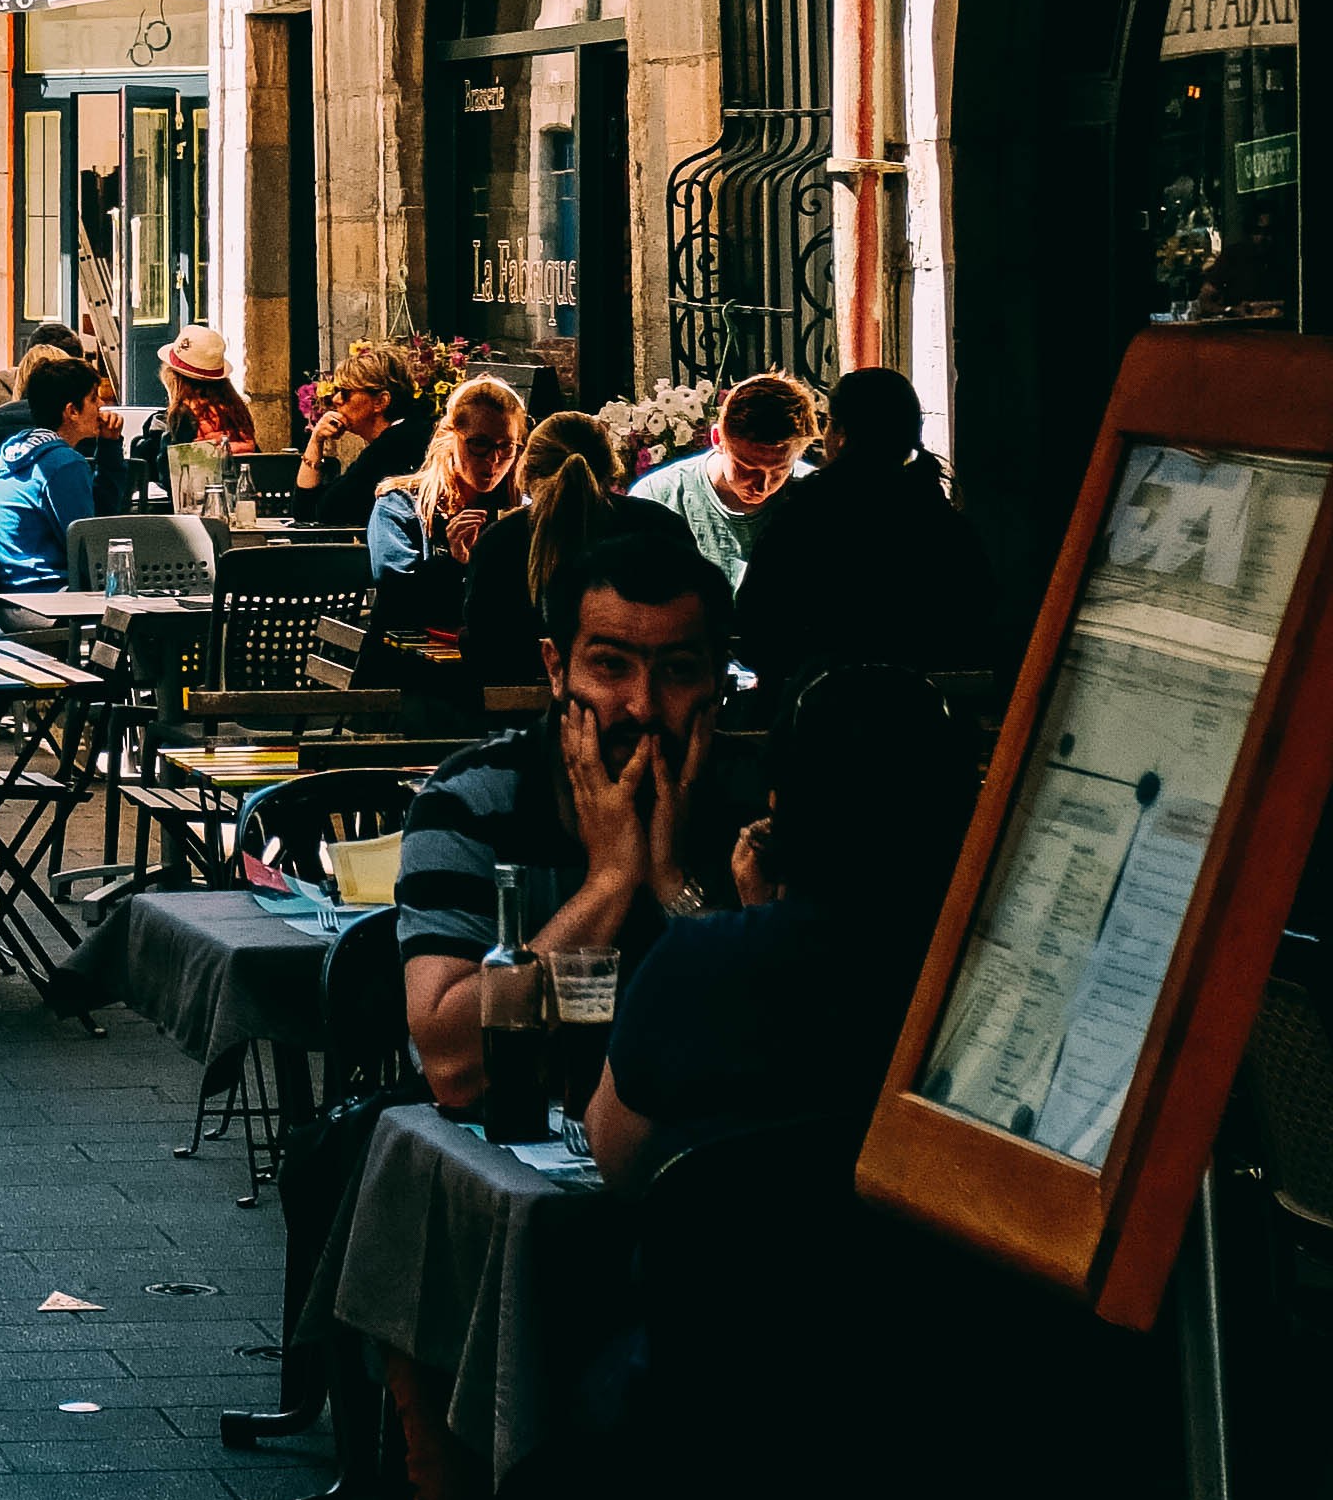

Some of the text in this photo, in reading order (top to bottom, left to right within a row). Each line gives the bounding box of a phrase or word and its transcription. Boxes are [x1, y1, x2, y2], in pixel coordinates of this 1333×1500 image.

[464, 76, 505, 112] Brasserie
[1243, 146, 1292, 179] OUVERT
[472, 237, 577, 327] La Fabrique
